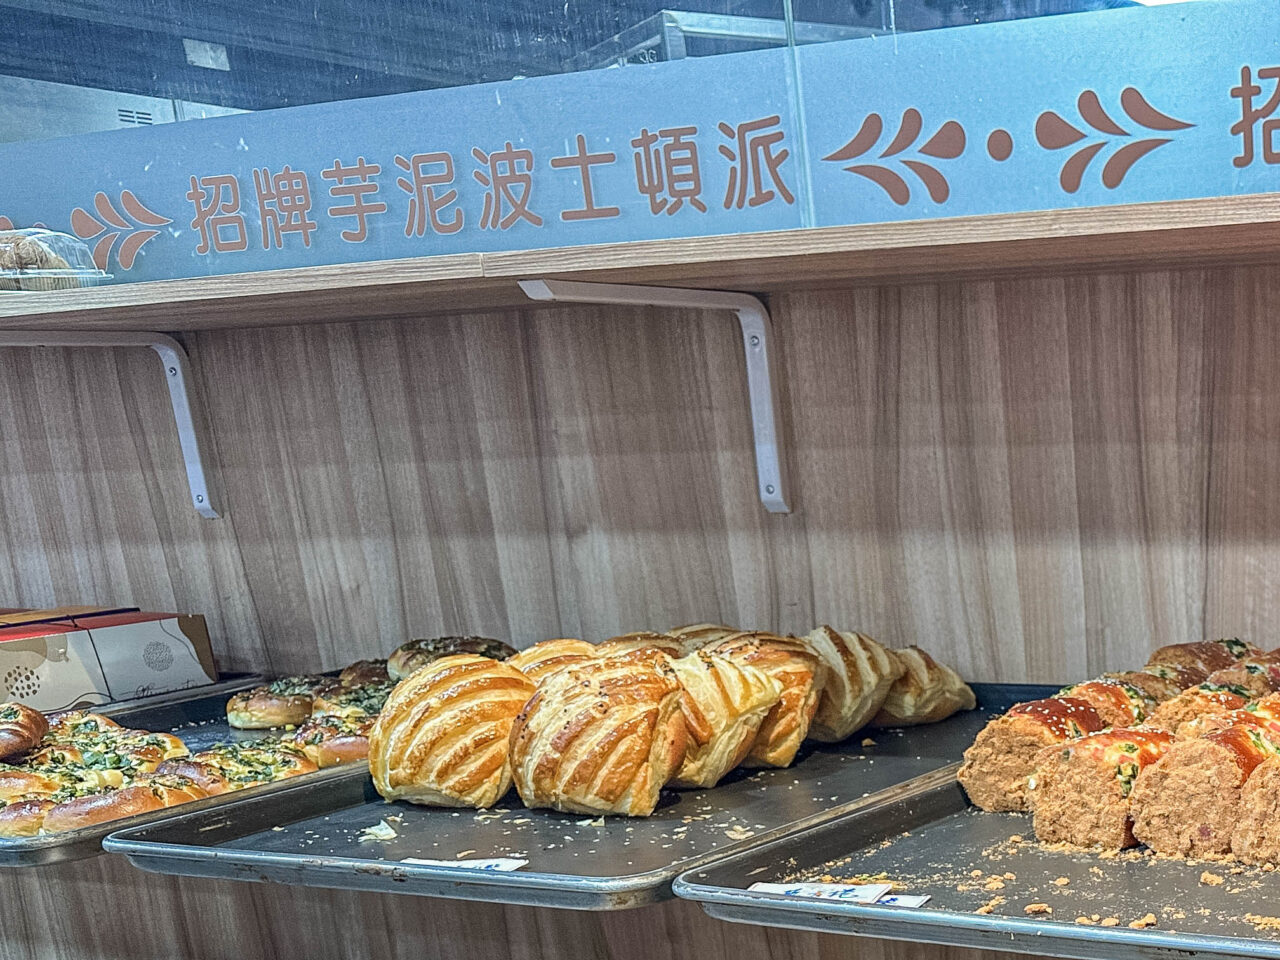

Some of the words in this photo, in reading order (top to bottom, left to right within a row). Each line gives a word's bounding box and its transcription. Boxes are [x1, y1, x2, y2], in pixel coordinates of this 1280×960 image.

[186, 114, 797, 256] 招牌芋泥波士頓派
